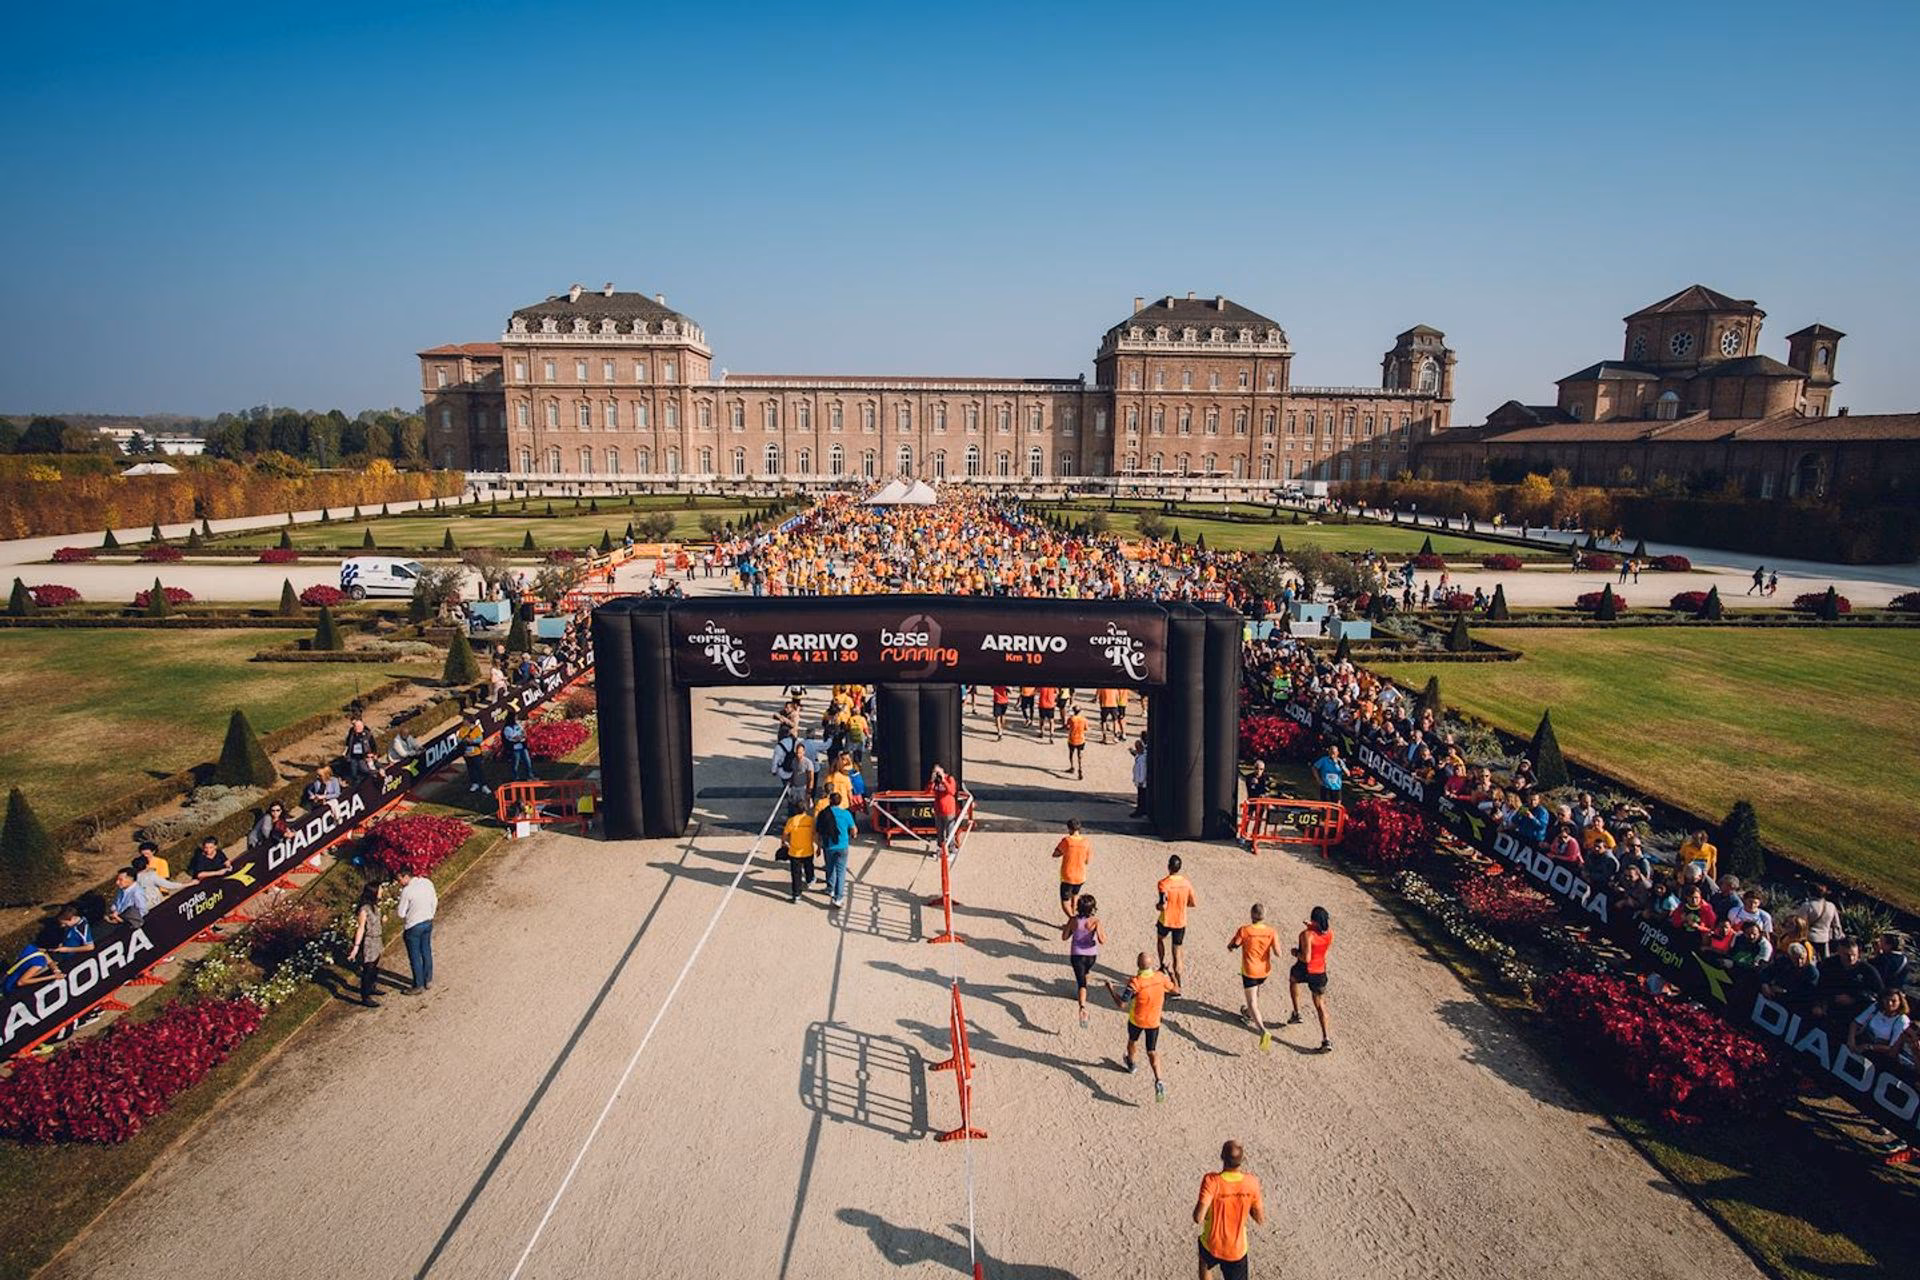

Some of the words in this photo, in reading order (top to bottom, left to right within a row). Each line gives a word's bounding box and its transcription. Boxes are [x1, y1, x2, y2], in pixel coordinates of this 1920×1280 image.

[688, 634, 734, 649] corsa
[771, 633, 858, 650] ARRIVO
[880, 628, 929, 646] base
[980, 634, 1067, 653] ARRIVO
[1089, 635, 1135, 652] corsa
[704, 644, 750, 678] Re
[771, 653, 789, 661] Km
[791, 651, 803, 662] 4
[812, 651, 828, 662] 21
[840, 651, 859, 662] 30
[880, 647, 959, 666] running
[1005, 653, 1023, 662] Km
[1026, 653, 1043, 664] 10
[1104, 645, 1149, 680] Re
[1359, 744, 1424, 802] DIADORA
[1493, 831, 1608, 923] DIADORA
[178, 891, 206, 914] make
[196, 888, 223, 915] bright
[1638, 921, 1669, 945] make
[1650, 940, 1684, 968] bright
[0, 928, 154, 1047] ADORA
[1751, 992, 1920, 1131] DIADO
